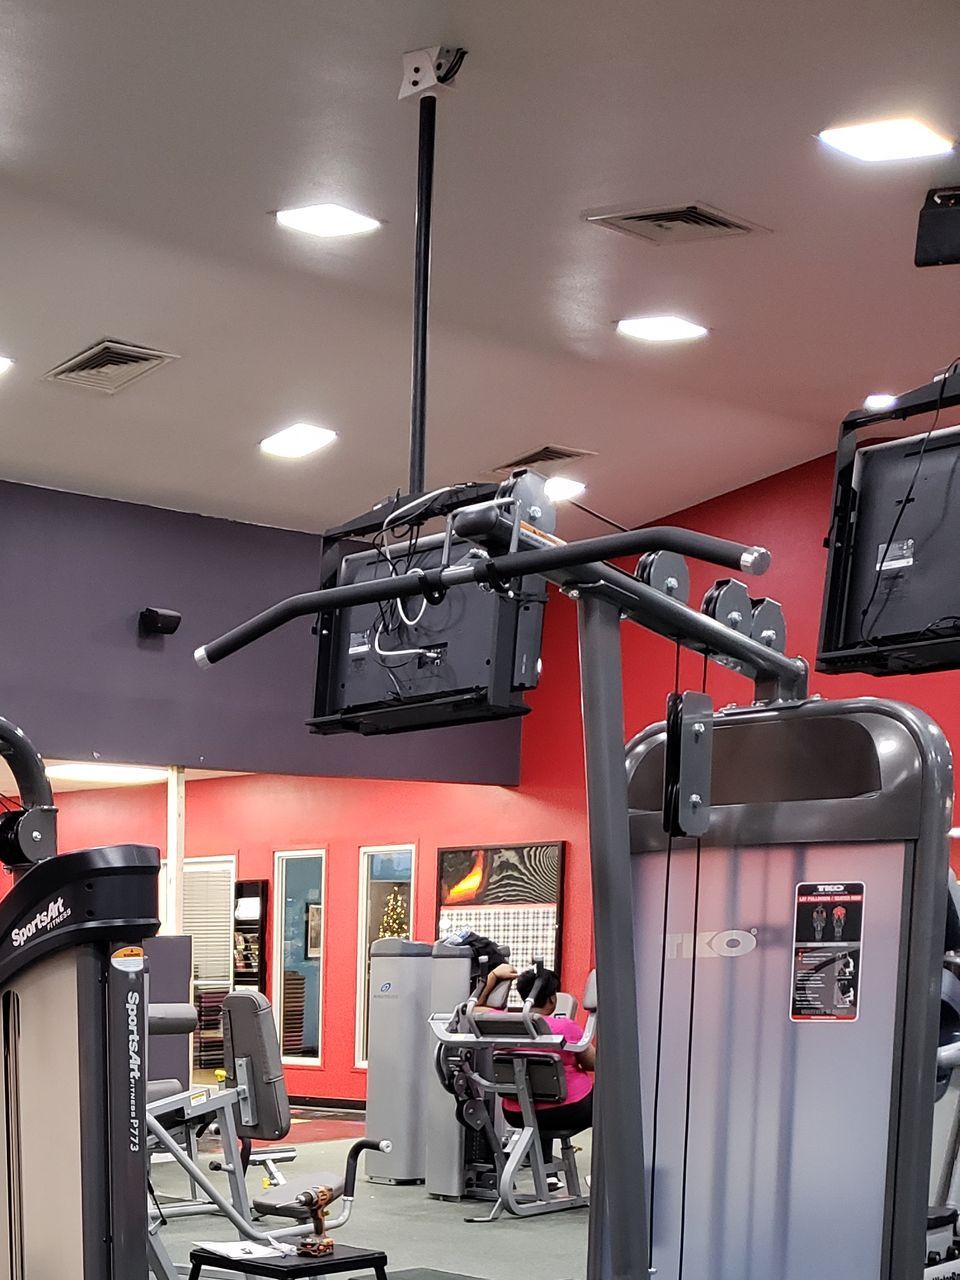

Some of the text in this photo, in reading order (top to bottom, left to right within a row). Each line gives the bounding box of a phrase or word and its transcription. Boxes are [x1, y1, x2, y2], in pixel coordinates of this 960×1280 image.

[817, 884, 844, 892] TKO
[11, 897, 65, 947] SportsArt
[46, 908, 72, 931] FITNESS
[126, 991, 140, 1080] SportsArt
[129, 1119, 140, 1152] P773
